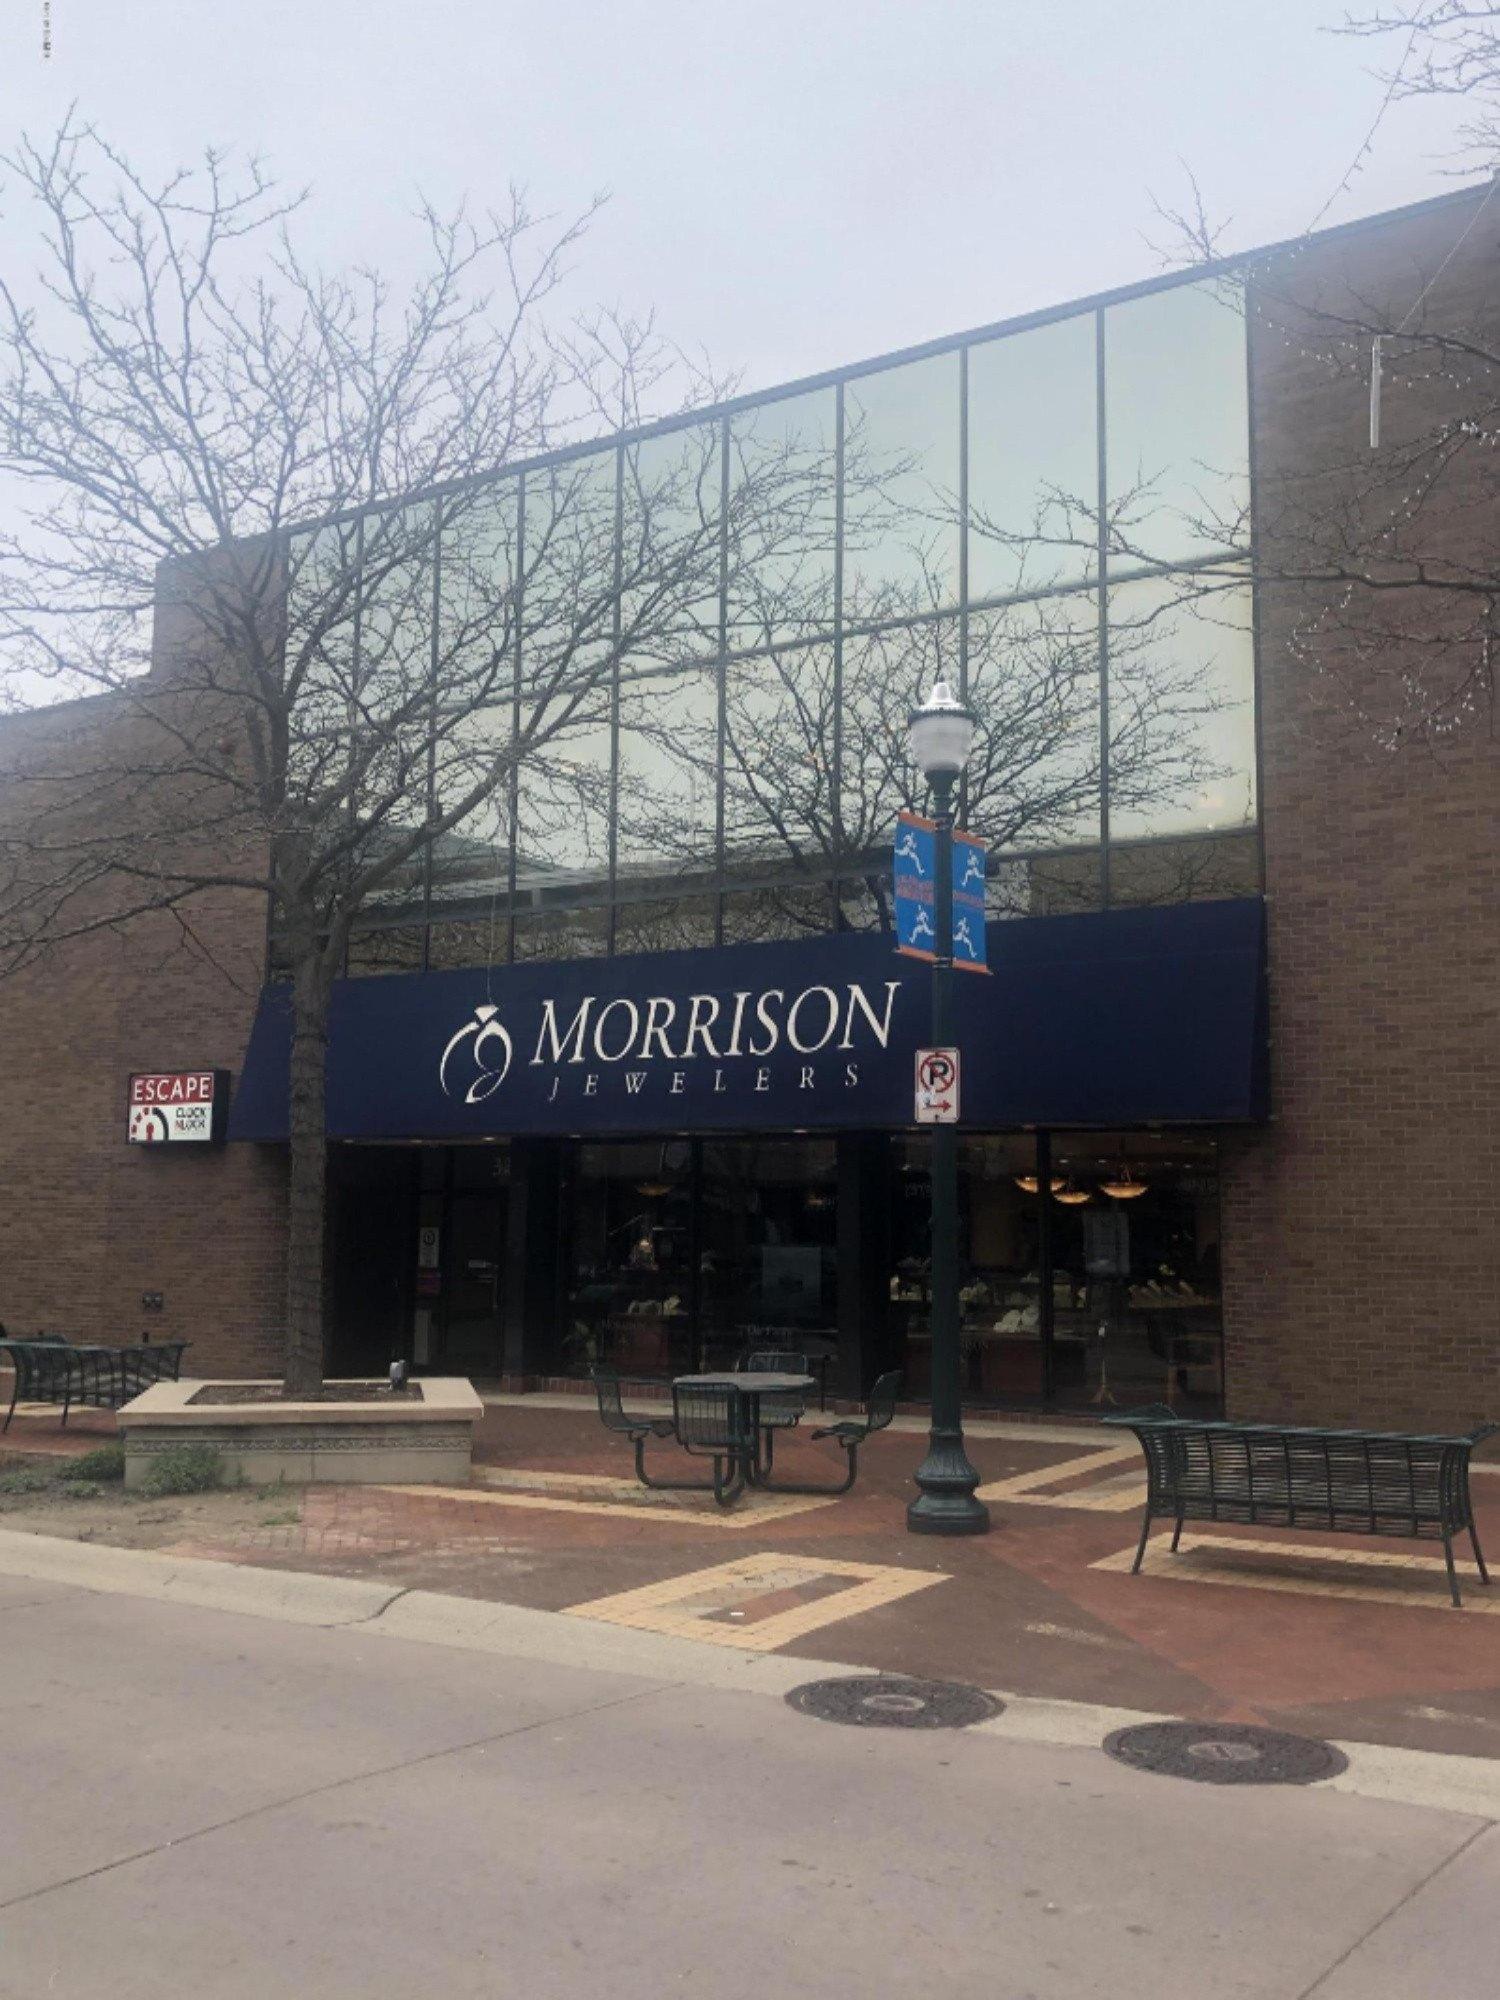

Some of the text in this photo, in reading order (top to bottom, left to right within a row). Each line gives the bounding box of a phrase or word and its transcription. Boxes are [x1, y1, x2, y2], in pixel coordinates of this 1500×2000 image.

[529, 981, 902, 1066] MORRISON
[546, 1063, 860, 1102] JEWELERS
[929, 1061, 950, 1085] P
[133, 1076, 211, 1102] ESCAPE
[176, 1107, 207, 1118] CLOCK
